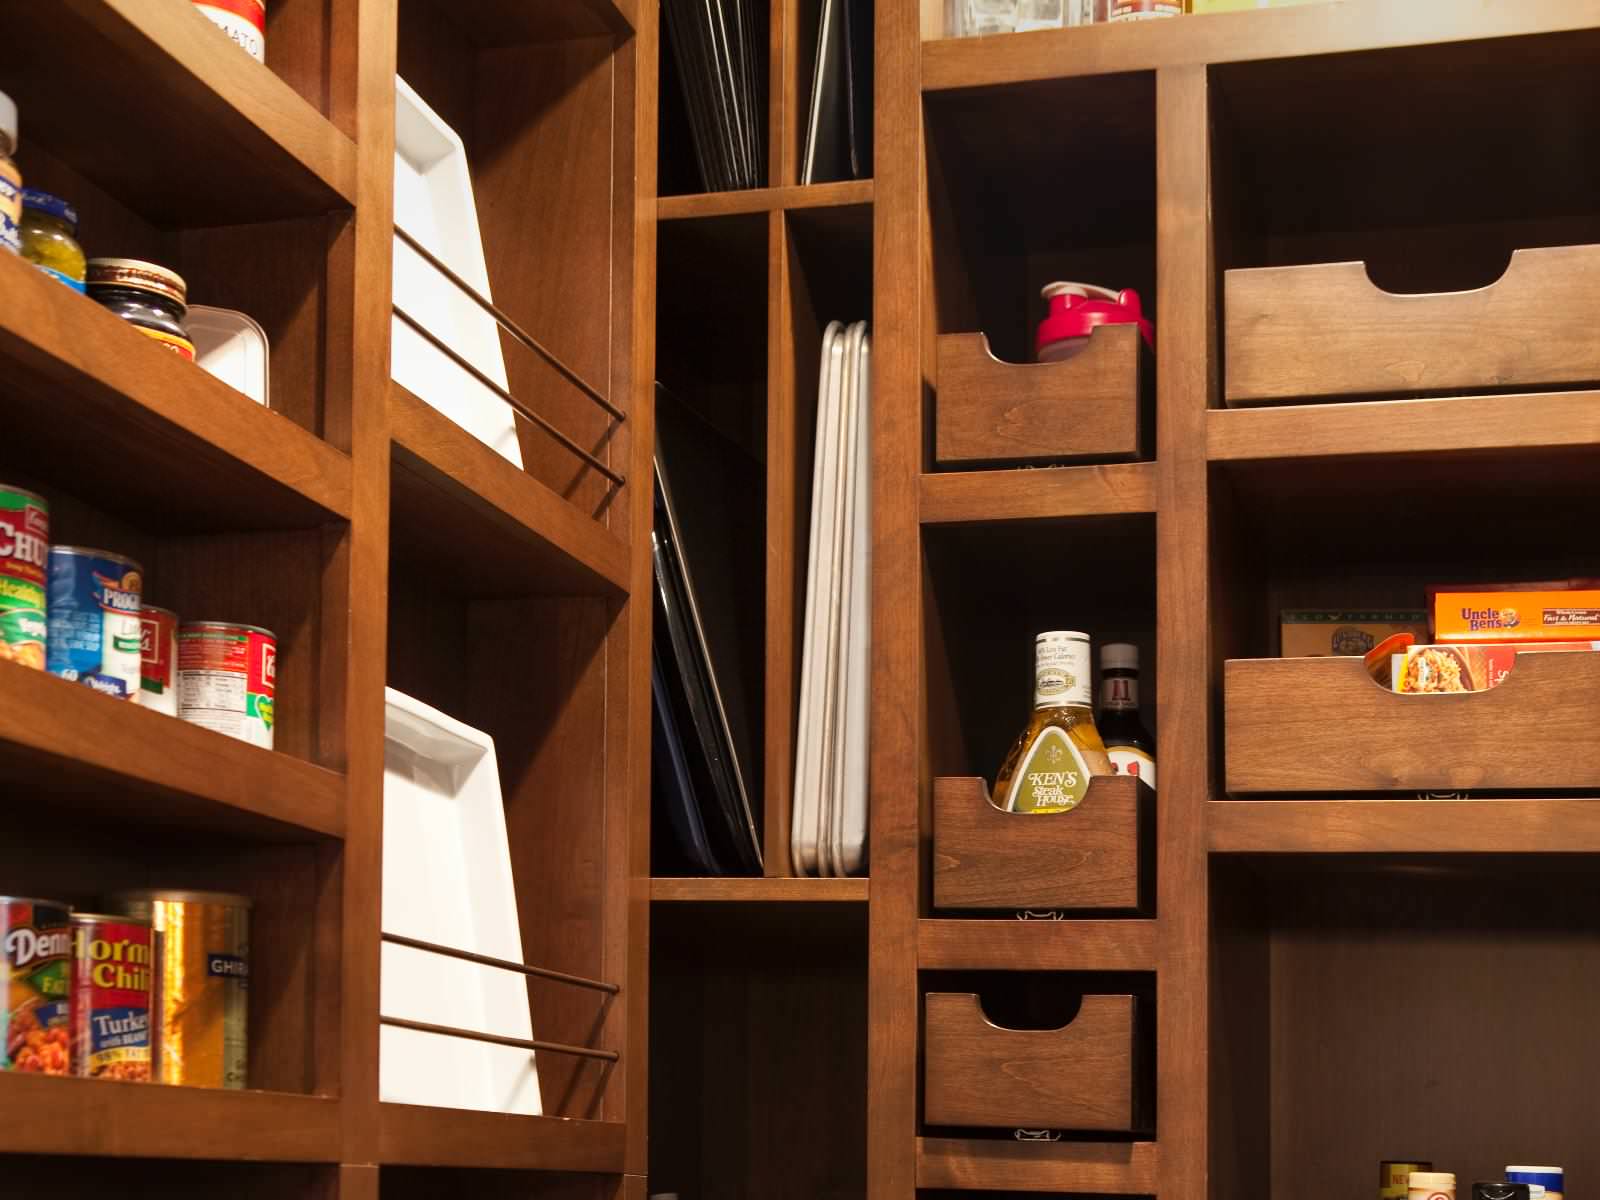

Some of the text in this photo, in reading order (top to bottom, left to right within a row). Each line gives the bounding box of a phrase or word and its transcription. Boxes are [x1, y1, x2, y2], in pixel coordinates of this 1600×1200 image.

[1461, 607, 1499, 620] Uncle
[1470, 619, 1501, 631] Ben's
[1028, 771, 1077, 788] KEN'S
[1033, 785, 1063, 796] Steak
